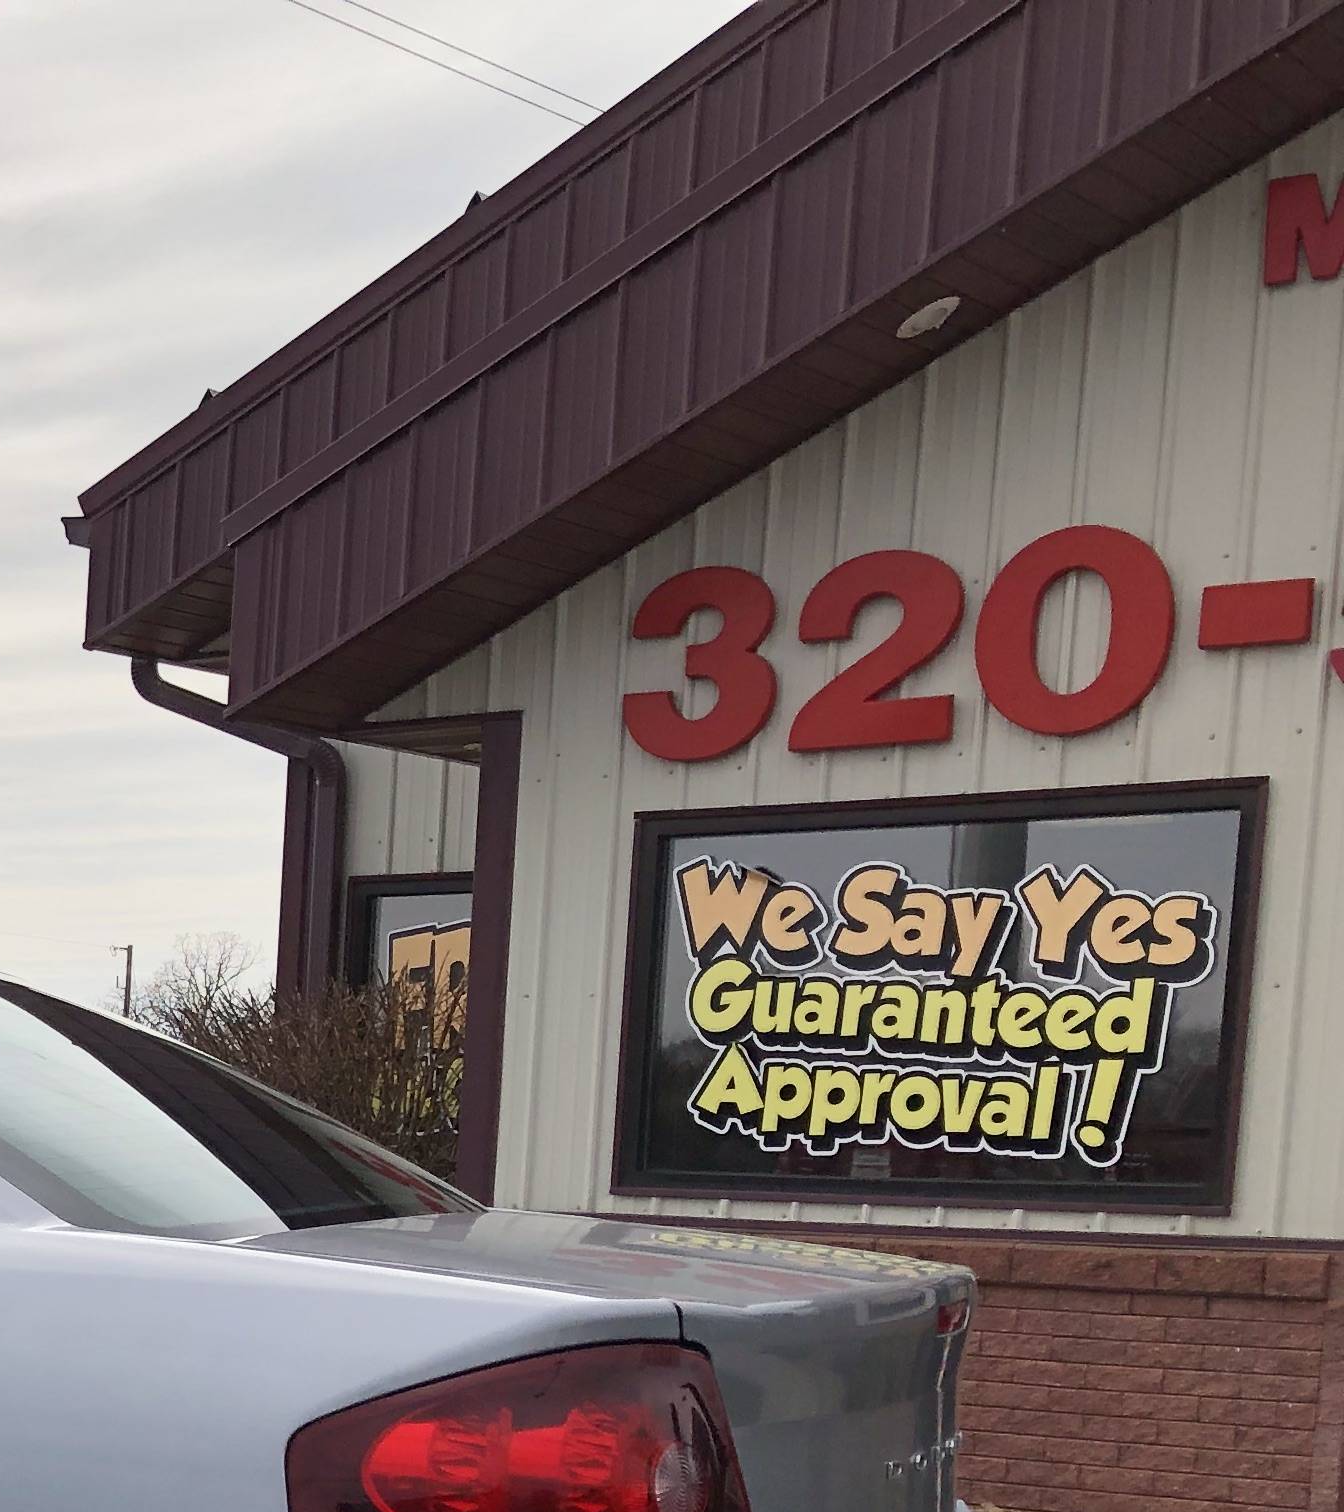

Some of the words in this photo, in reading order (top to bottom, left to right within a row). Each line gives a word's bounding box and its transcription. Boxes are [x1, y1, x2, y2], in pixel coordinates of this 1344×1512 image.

[622, 524, 1344, 762] 320-
[679, 861, 814, 957] We
[833, 867, 1006, 977] Say
[1020, 868, 1200, 966] Yes
[691, 958, 1156, 1054] Guaranteed
